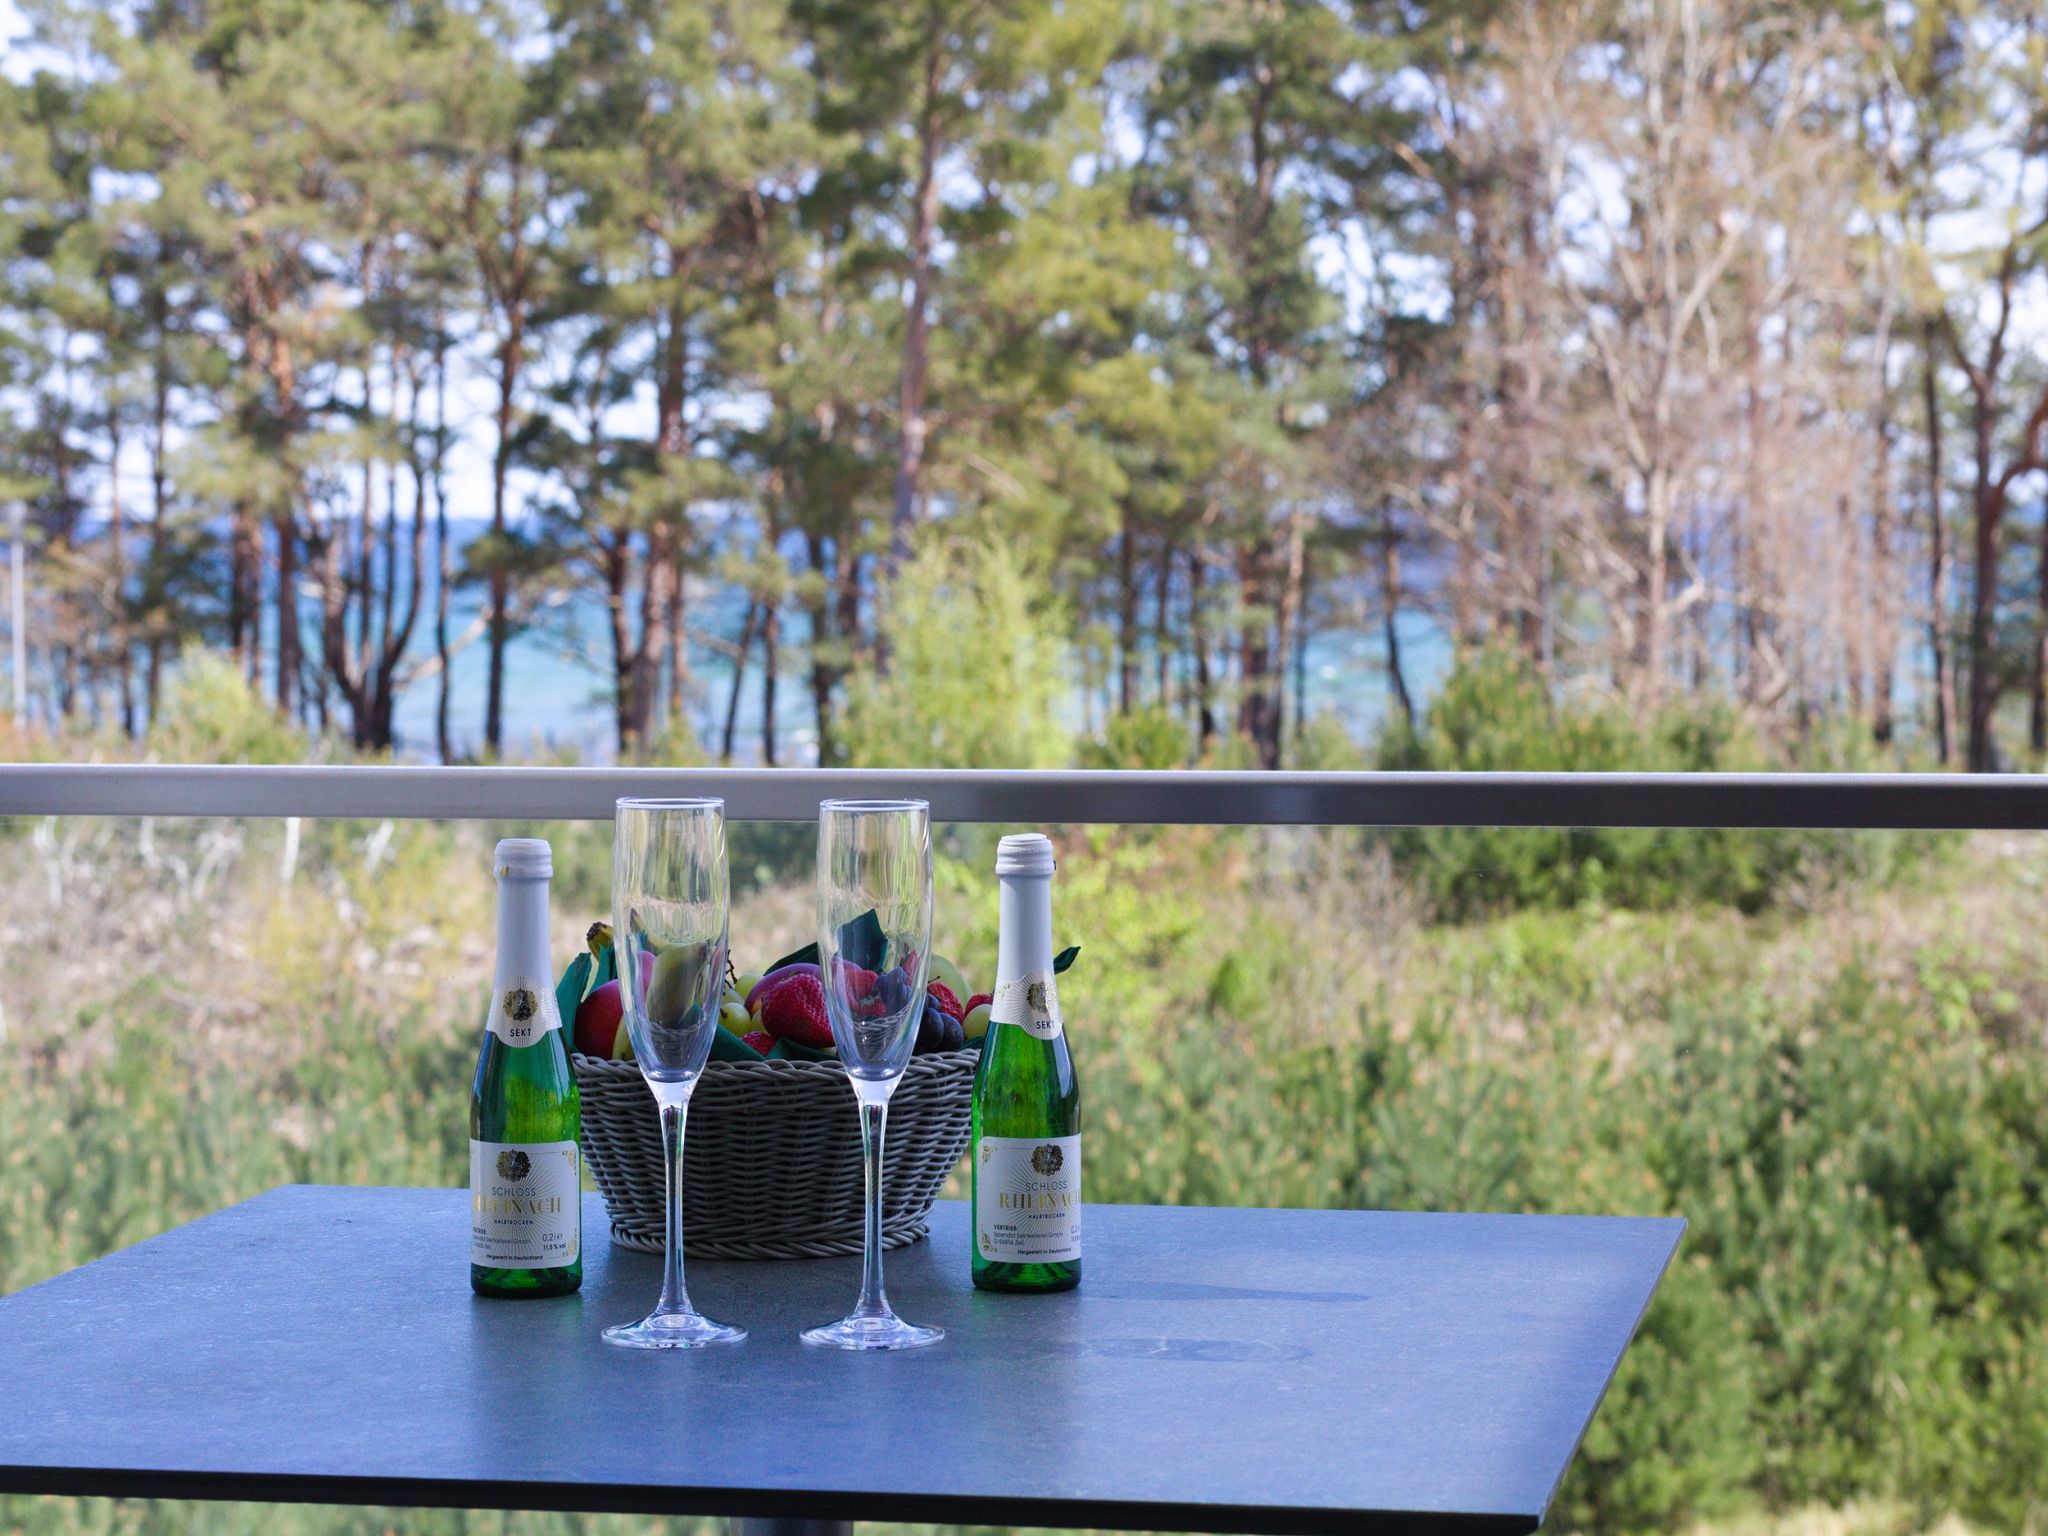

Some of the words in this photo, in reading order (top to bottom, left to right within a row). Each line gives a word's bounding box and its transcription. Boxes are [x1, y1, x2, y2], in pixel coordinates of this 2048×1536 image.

[1036, 1020, 1054, 1030] SEKT
[509, 1028, 532, 1037] SEKT
[1025, 1181, 1067, 1191] SCHLOSS
[491, 1187, 536, 1197] SCHLOSS
